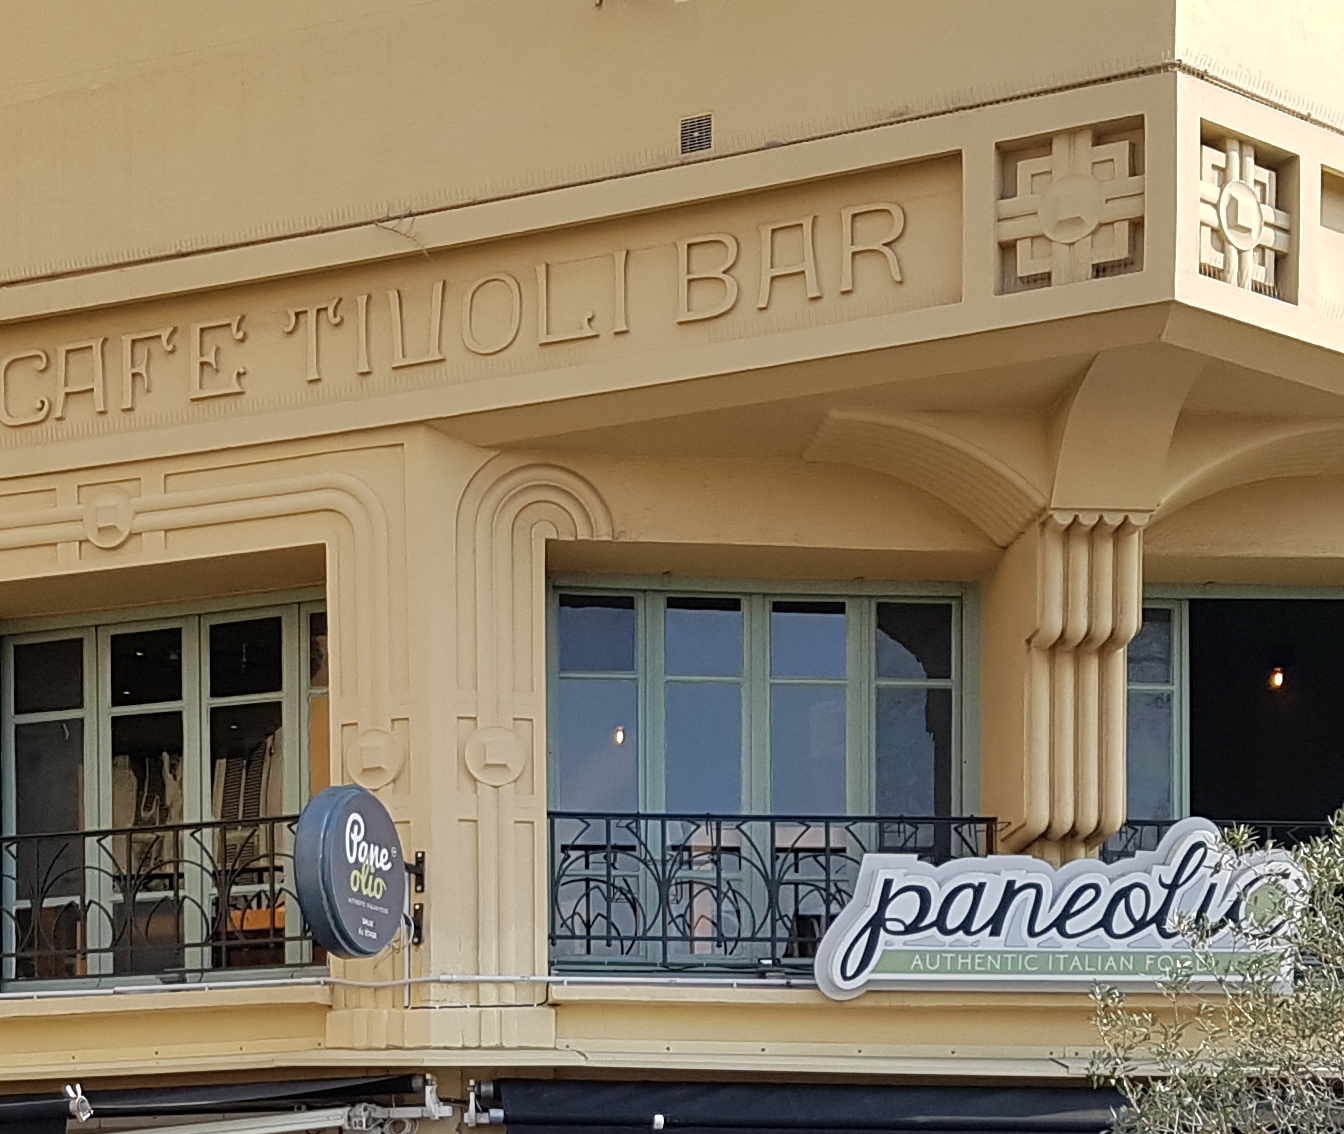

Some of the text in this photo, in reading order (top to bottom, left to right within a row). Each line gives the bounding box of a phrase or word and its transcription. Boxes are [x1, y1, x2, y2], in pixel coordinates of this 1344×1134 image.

[674, 200, 907, 326] BAR
[344, 812, 393, 871] Pane
[910, 953, 1040, 972] AUTHENTIC
[1047, 953, 1134, 972] ITALIAN
